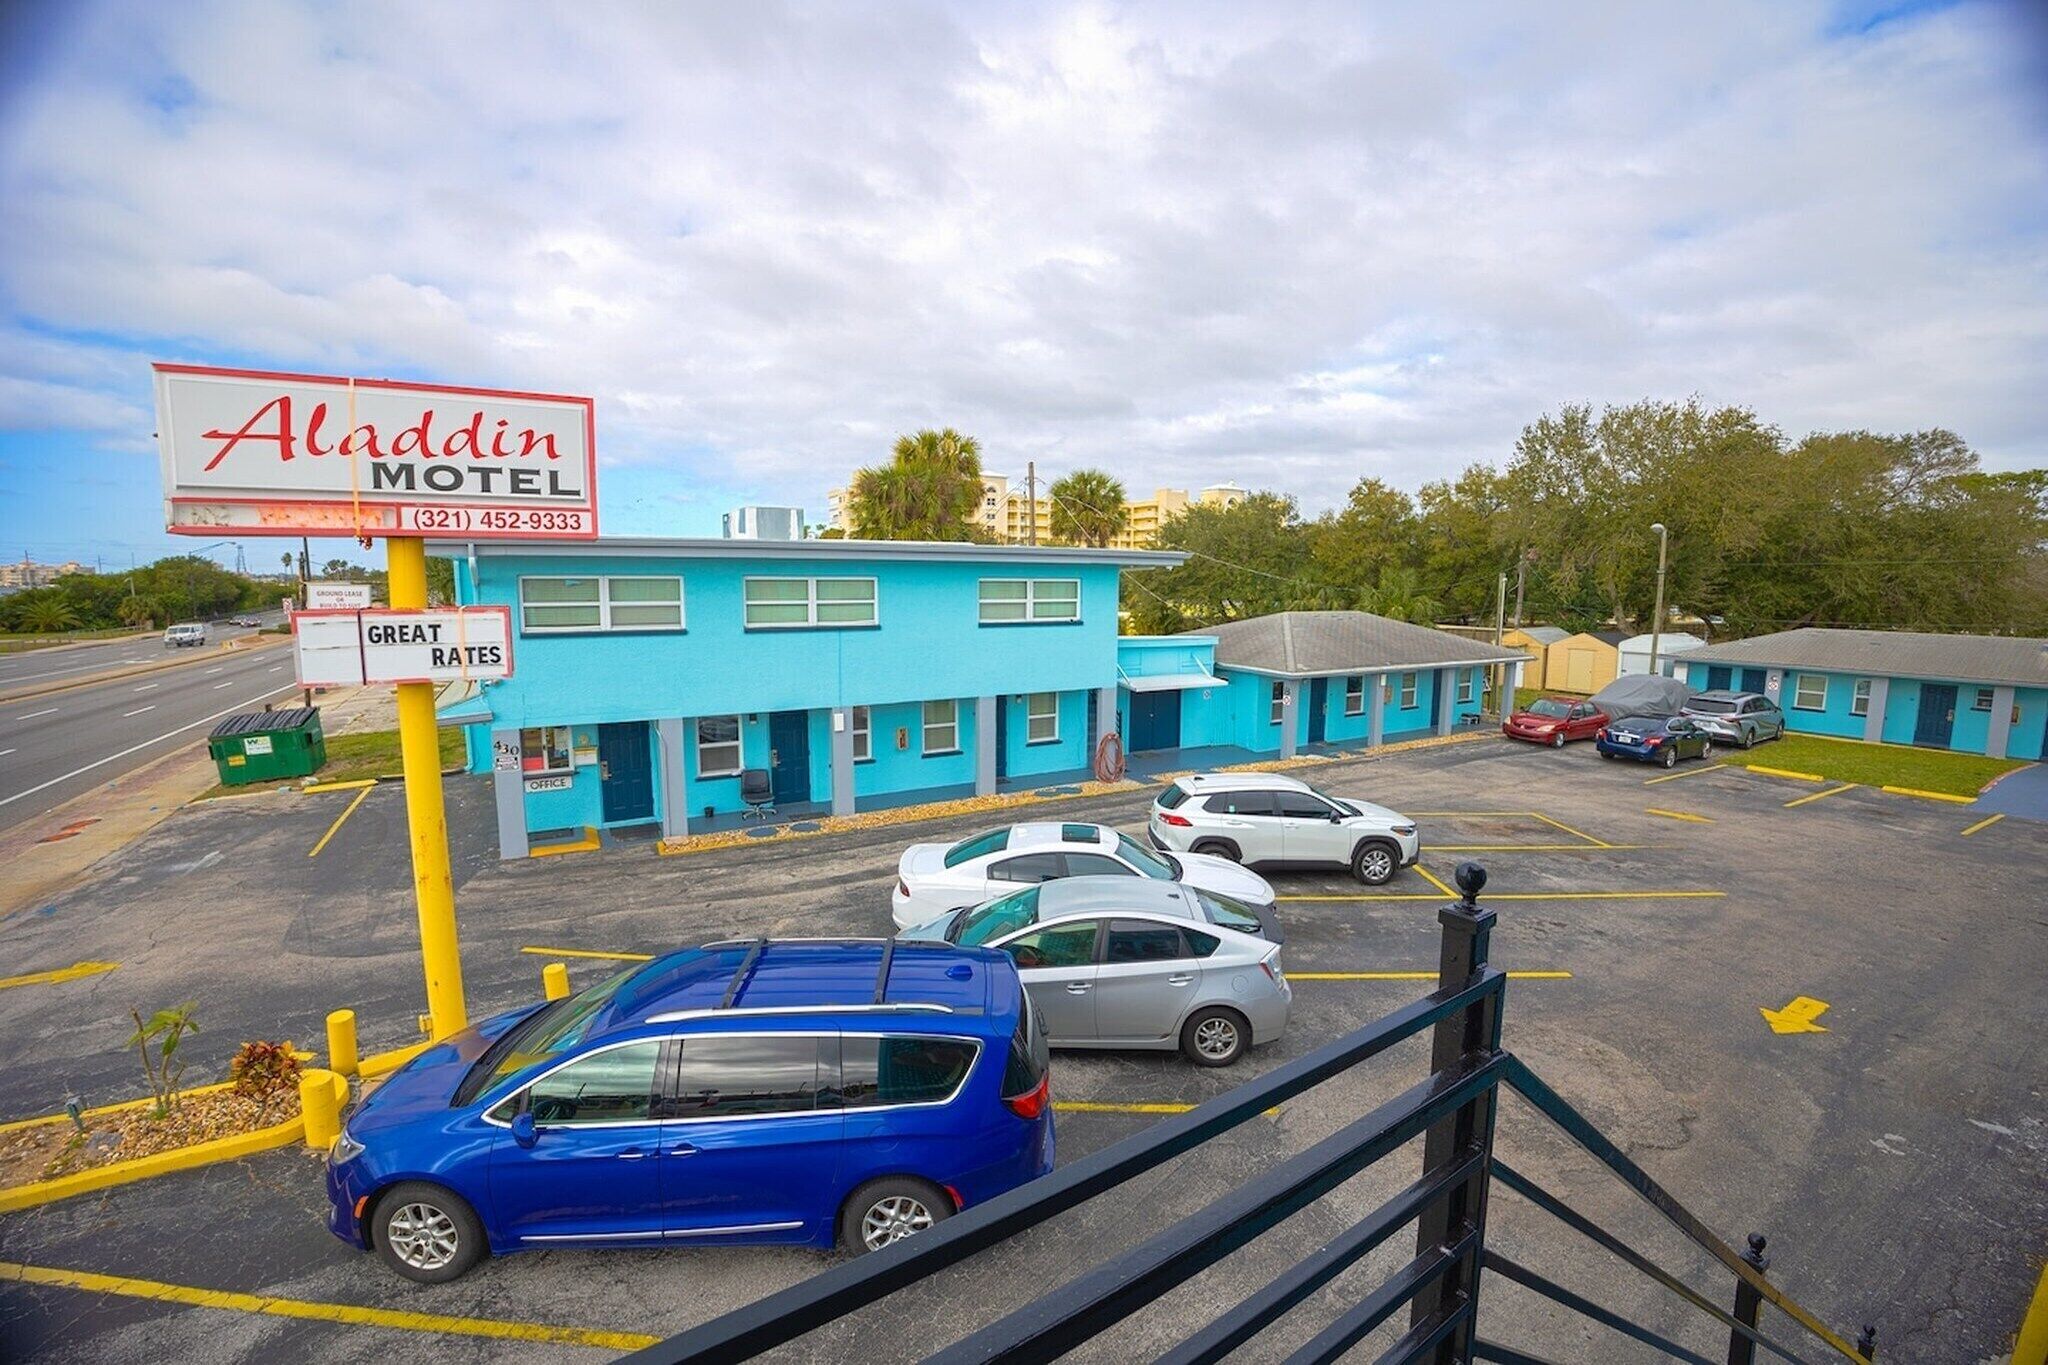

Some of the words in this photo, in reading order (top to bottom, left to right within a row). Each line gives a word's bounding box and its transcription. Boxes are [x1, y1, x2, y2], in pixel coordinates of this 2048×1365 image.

[201, 395, 562, 471] Aladdin
[372, 461, 581, 497] MOTEL
[414, 508, 471, 530] (321)
[480, 510, 582, 530] 452-9333
[367, 623, 442, 644] GREAT
[431, 645, 502, 666] RATES
[494, 741, 520, 756] 430
[530, 778, 567, 790] OFFICE
